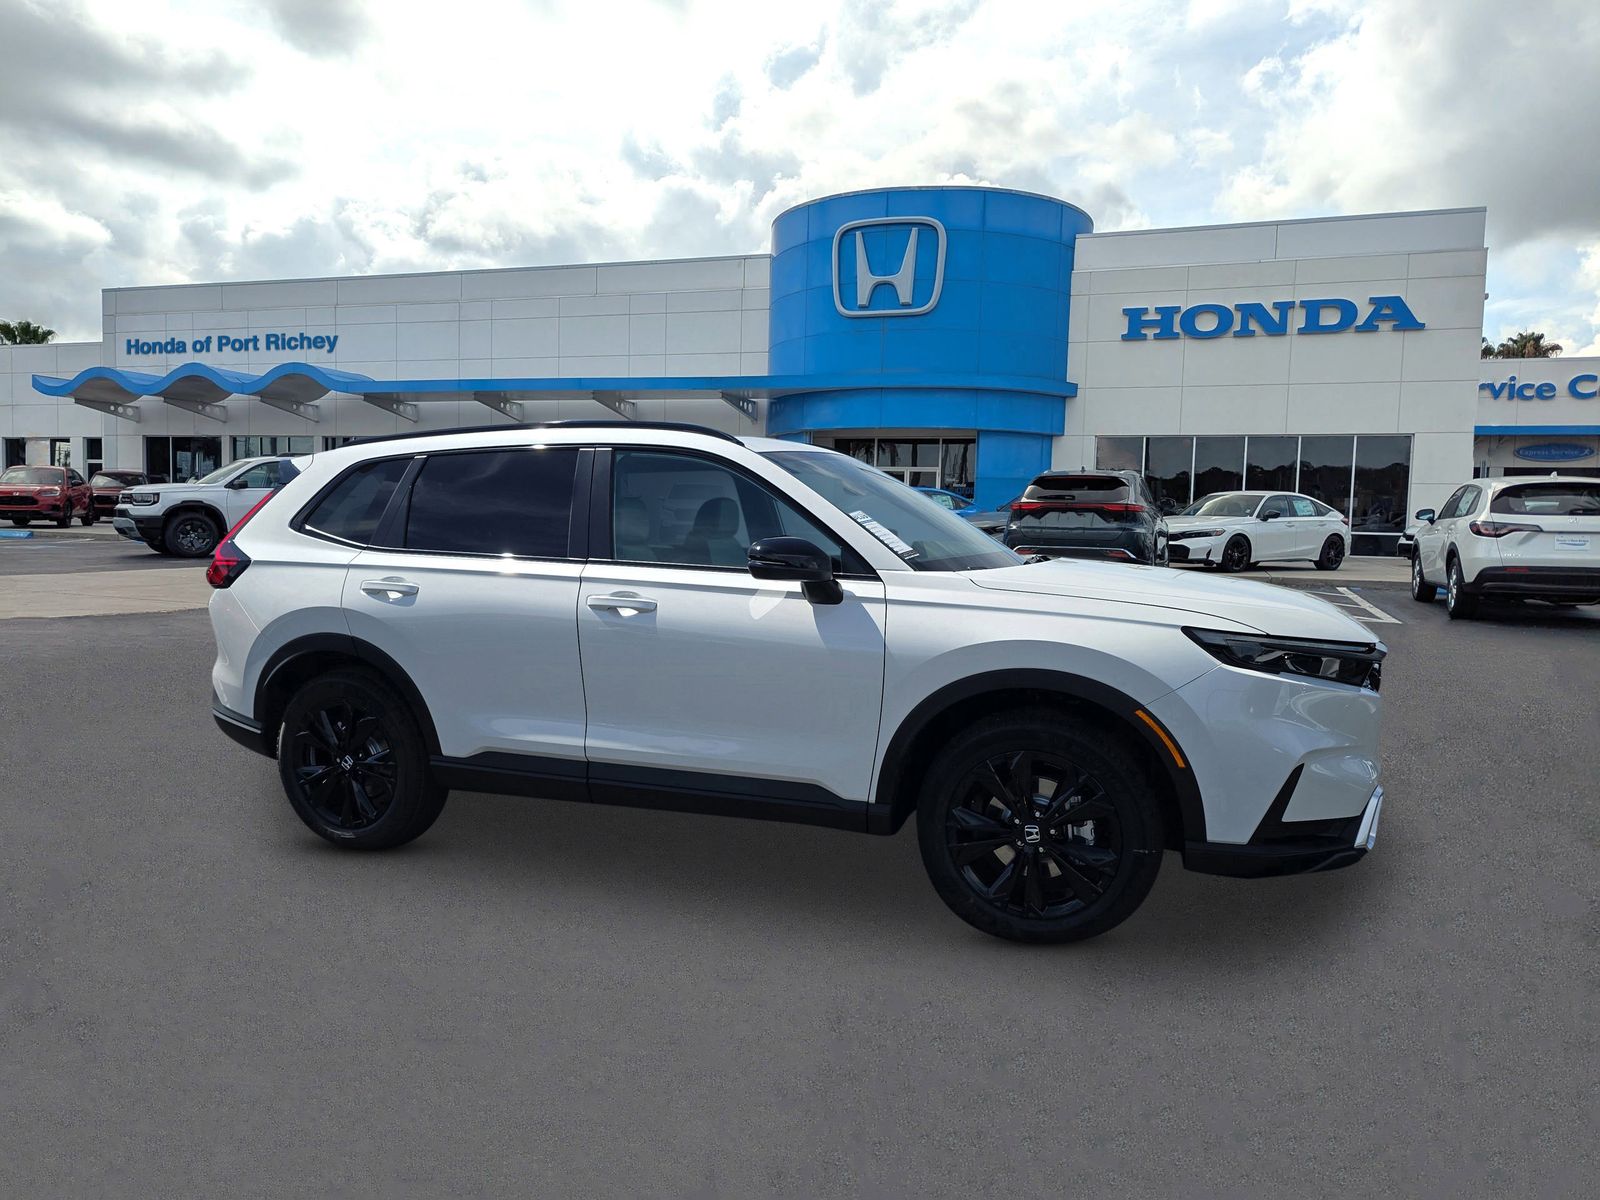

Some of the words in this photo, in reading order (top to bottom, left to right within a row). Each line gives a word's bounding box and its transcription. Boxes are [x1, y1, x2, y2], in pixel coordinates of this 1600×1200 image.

[1121, 296, 1425, 341] HONDA
[126, 338, 187, 355] Honda
[192, 336, 211, 353] of
[217, 335, 260, 352] Port
[265, 332, 339, 354] Richey
[1568, 374, 1600, 400] C
